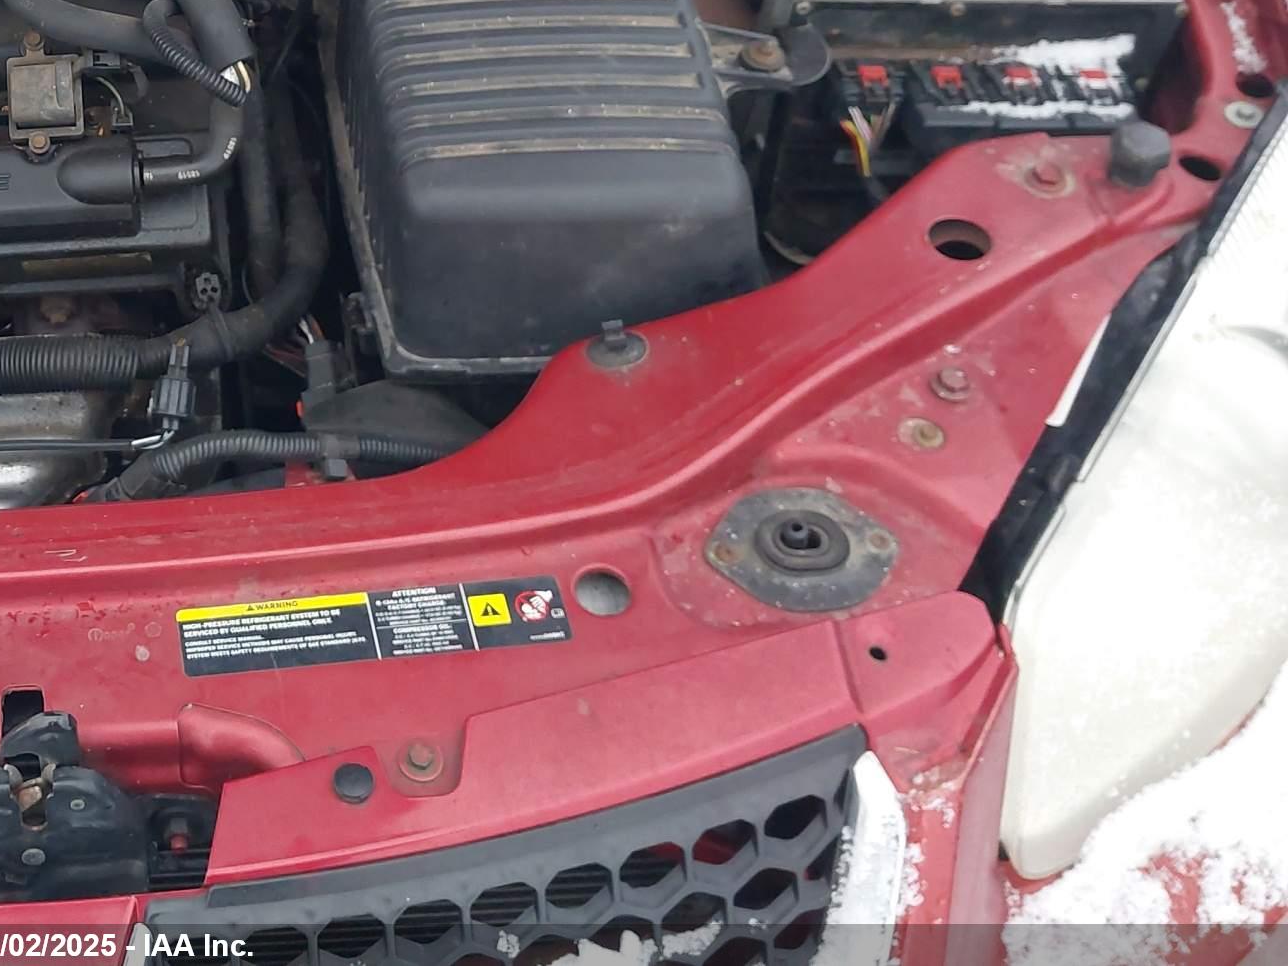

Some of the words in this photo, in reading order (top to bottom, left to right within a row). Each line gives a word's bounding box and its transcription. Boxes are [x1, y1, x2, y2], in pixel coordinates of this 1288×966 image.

[392, 586, 436, 598] ATTENTION
[256, 600, 298, 611] WARNING
[241, 614, 290, 625] REFRIGERANT
[290, 611, 319, 620] SYSTEM
[330, 608, 341, 616] BE
[184, 628, 219, 638] SERVICED
[230, 624, 268, 634] QUALIFIED
[269, 619, 311, 629] PERSONNEL
[185, 639, 211, 647] CONSULT
[212, 637, 237, 645] SERVICE
